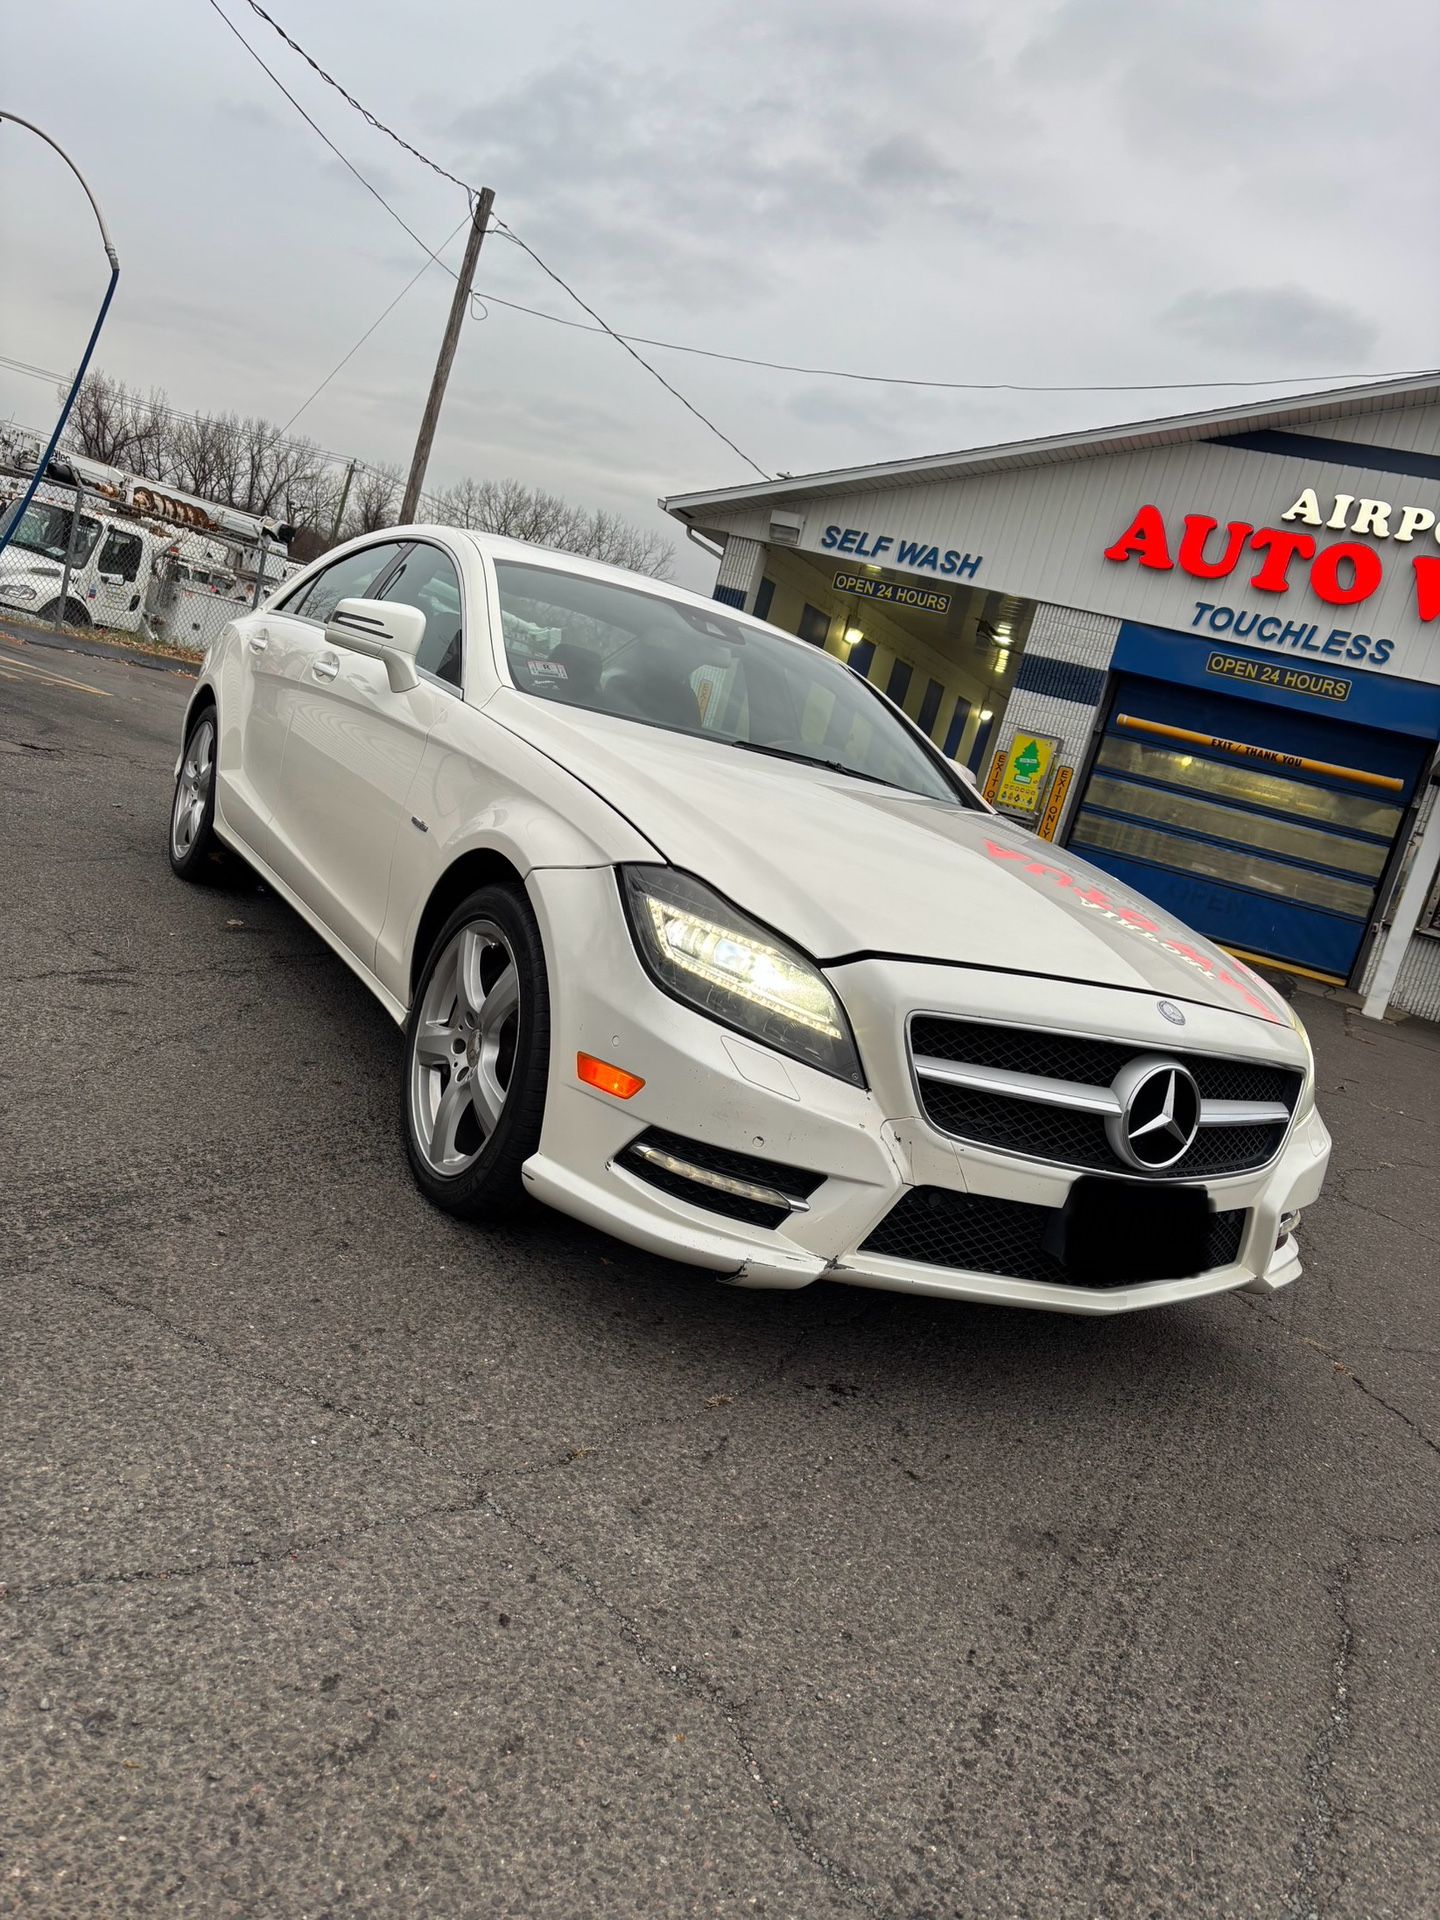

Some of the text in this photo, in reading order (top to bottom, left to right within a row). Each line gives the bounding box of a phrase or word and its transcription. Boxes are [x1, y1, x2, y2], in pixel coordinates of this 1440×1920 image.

[1281, 488, 1440, 546] AIRP
[821, 525, 983, 578] SELF WASH
[1104, 504, 1383, 606] AUTO
[836, 575, 947, 610] OPEN 24 HOURS
[1191, 601, 1395, 664] TOUCHLESS
[1211, 656, 1347, 697] OPEN 24 HOURS
[992, 754, 1006, 787] EXIT
[1211, 738, 1233, 751] EXIT
[1245, 746, 1279, 761] THANK
[1282, 755, 1303, 767] YOU
[1041, 769, 1069, 838] EXIT ONLY
